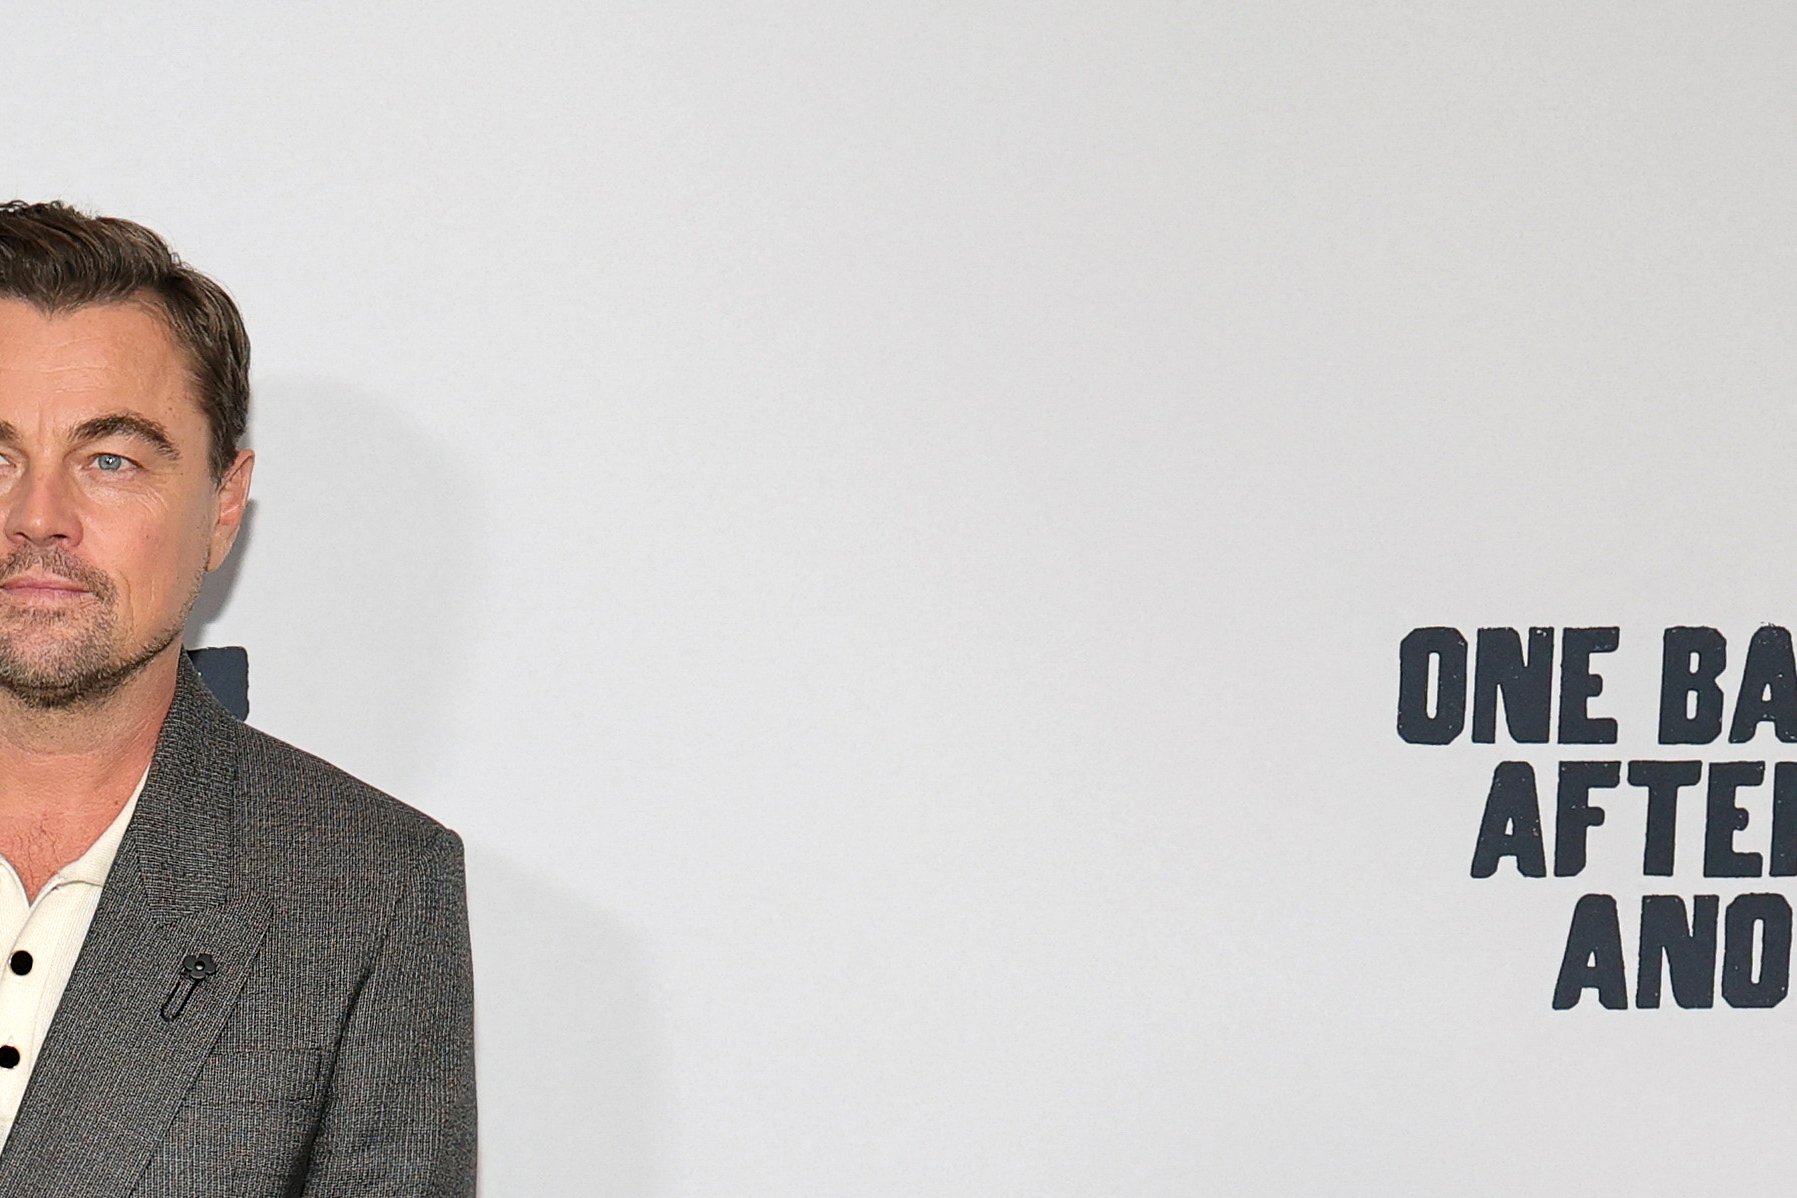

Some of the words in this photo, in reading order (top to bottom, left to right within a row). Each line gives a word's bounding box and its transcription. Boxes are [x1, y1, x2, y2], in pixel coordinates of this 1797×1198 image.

[1397, 626, 1621, 746] ONE
[1657, 623, 1797, 746] BA
[1552, 893, 1793, 1011] ANO
